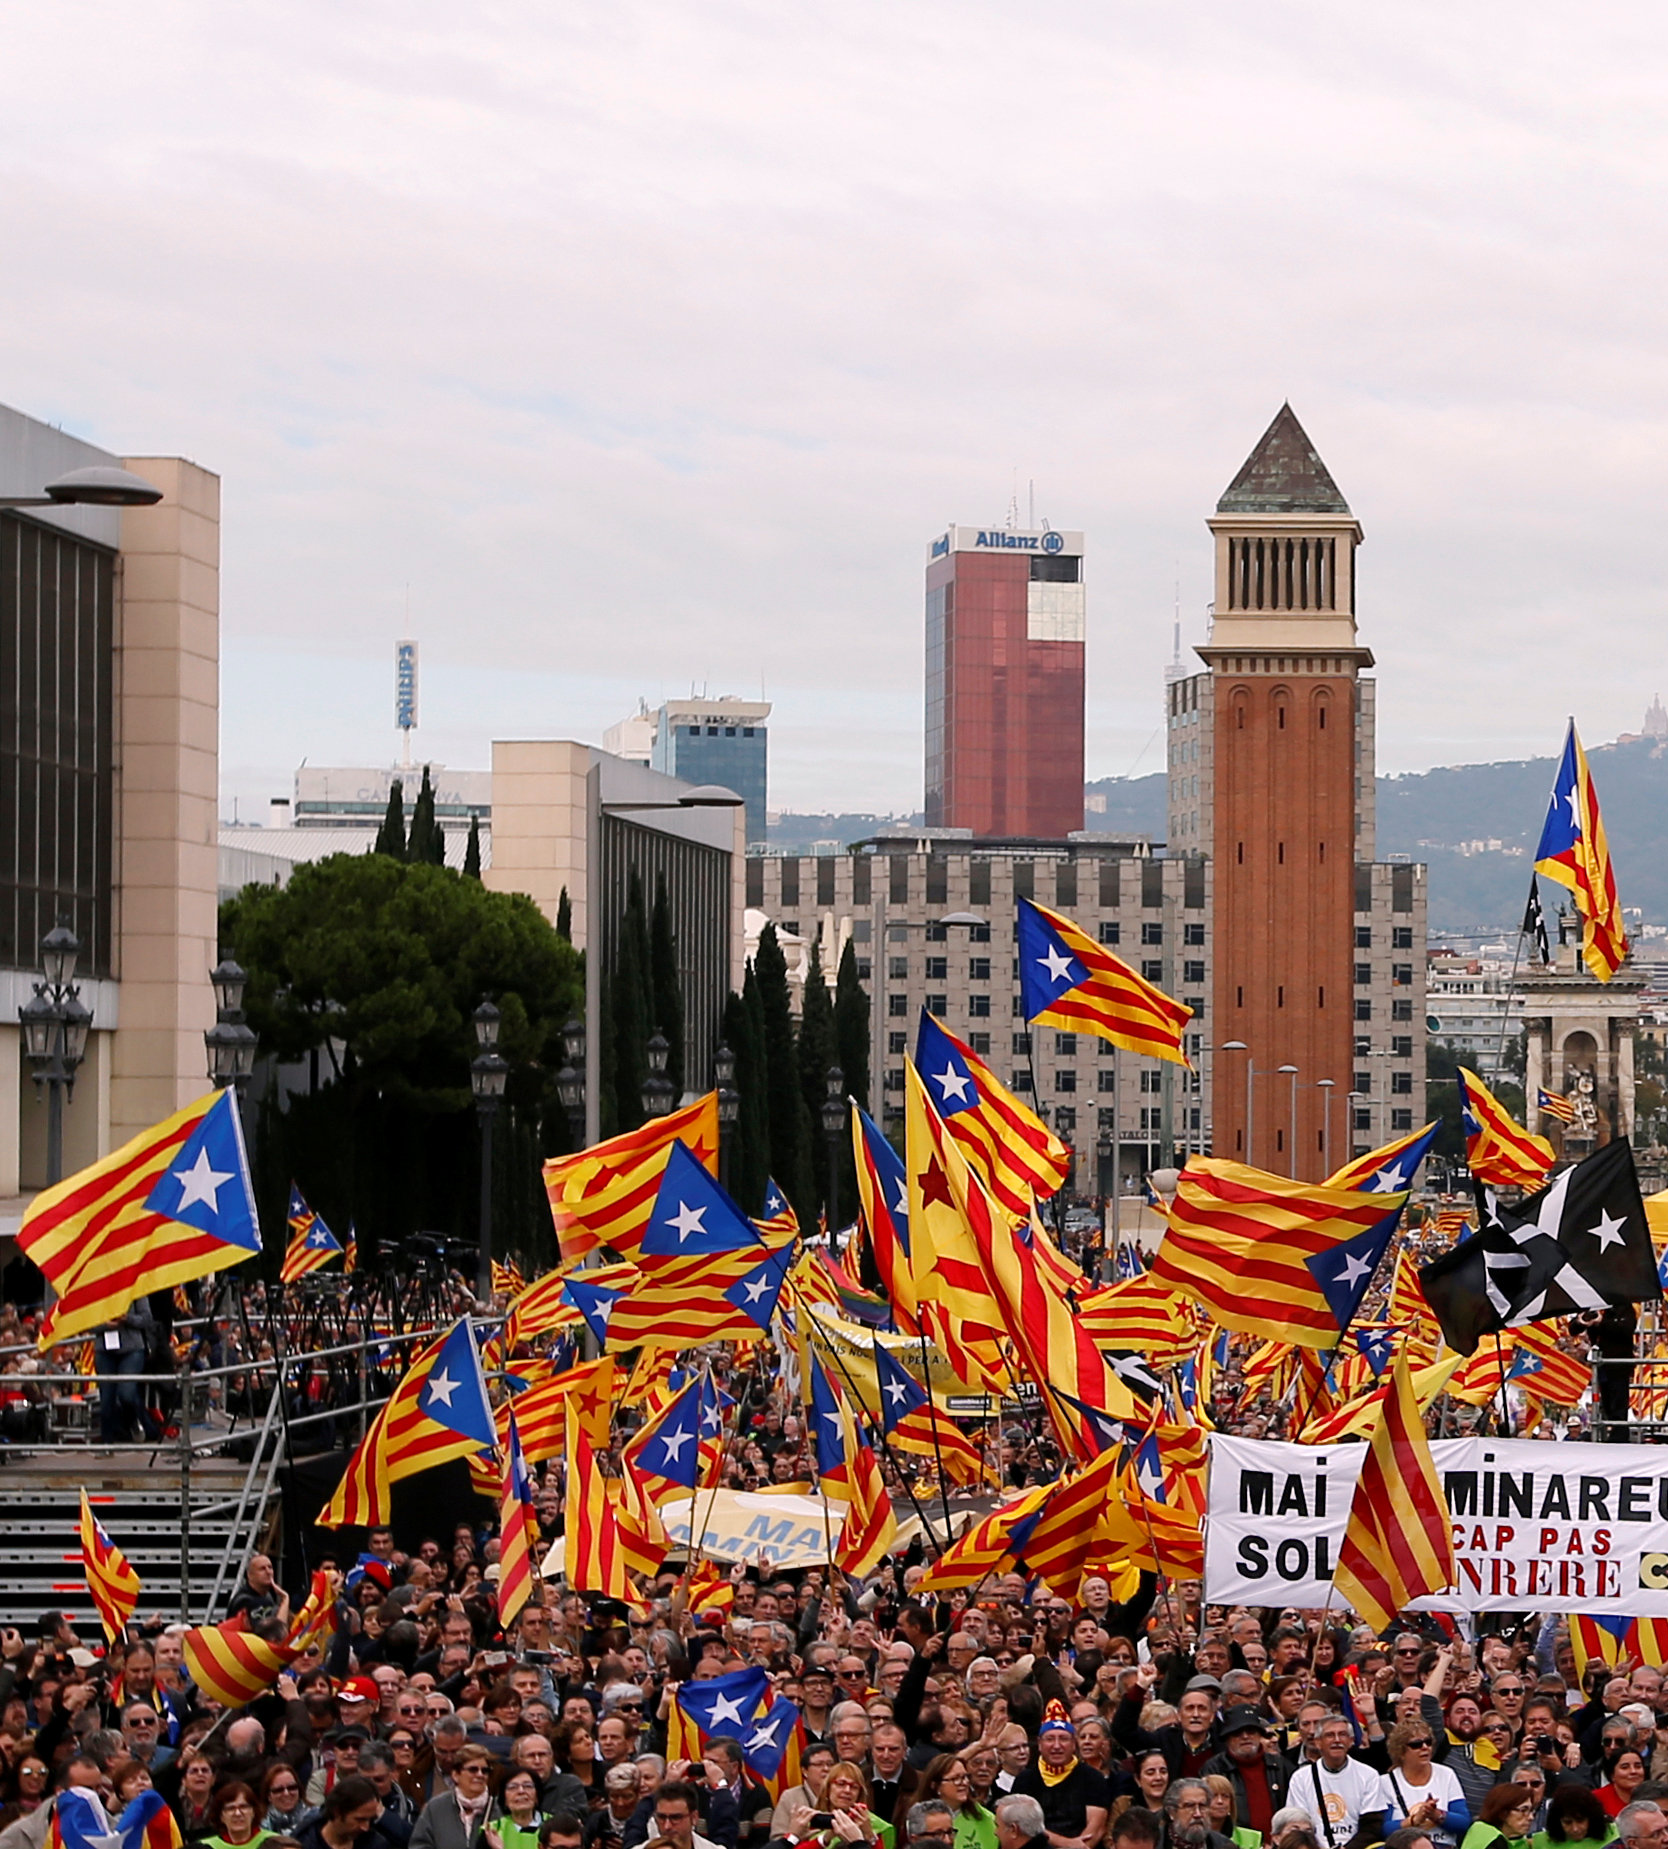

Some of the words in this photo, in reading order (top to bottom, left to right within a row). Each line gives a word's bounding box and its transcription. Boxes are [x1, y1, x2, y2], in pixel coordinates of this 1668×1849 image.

[975, 531, 1039, 549] Allianz
[399, 645, 414, 725] PHILIPS
[1236, 1534, 1335, 1581] SOL
[1452, 1524, 1515, 1551] CAP
[1538, 1527, 1612, 1556] PAS
[1436, 1557, 1622, 1598] NRERE
